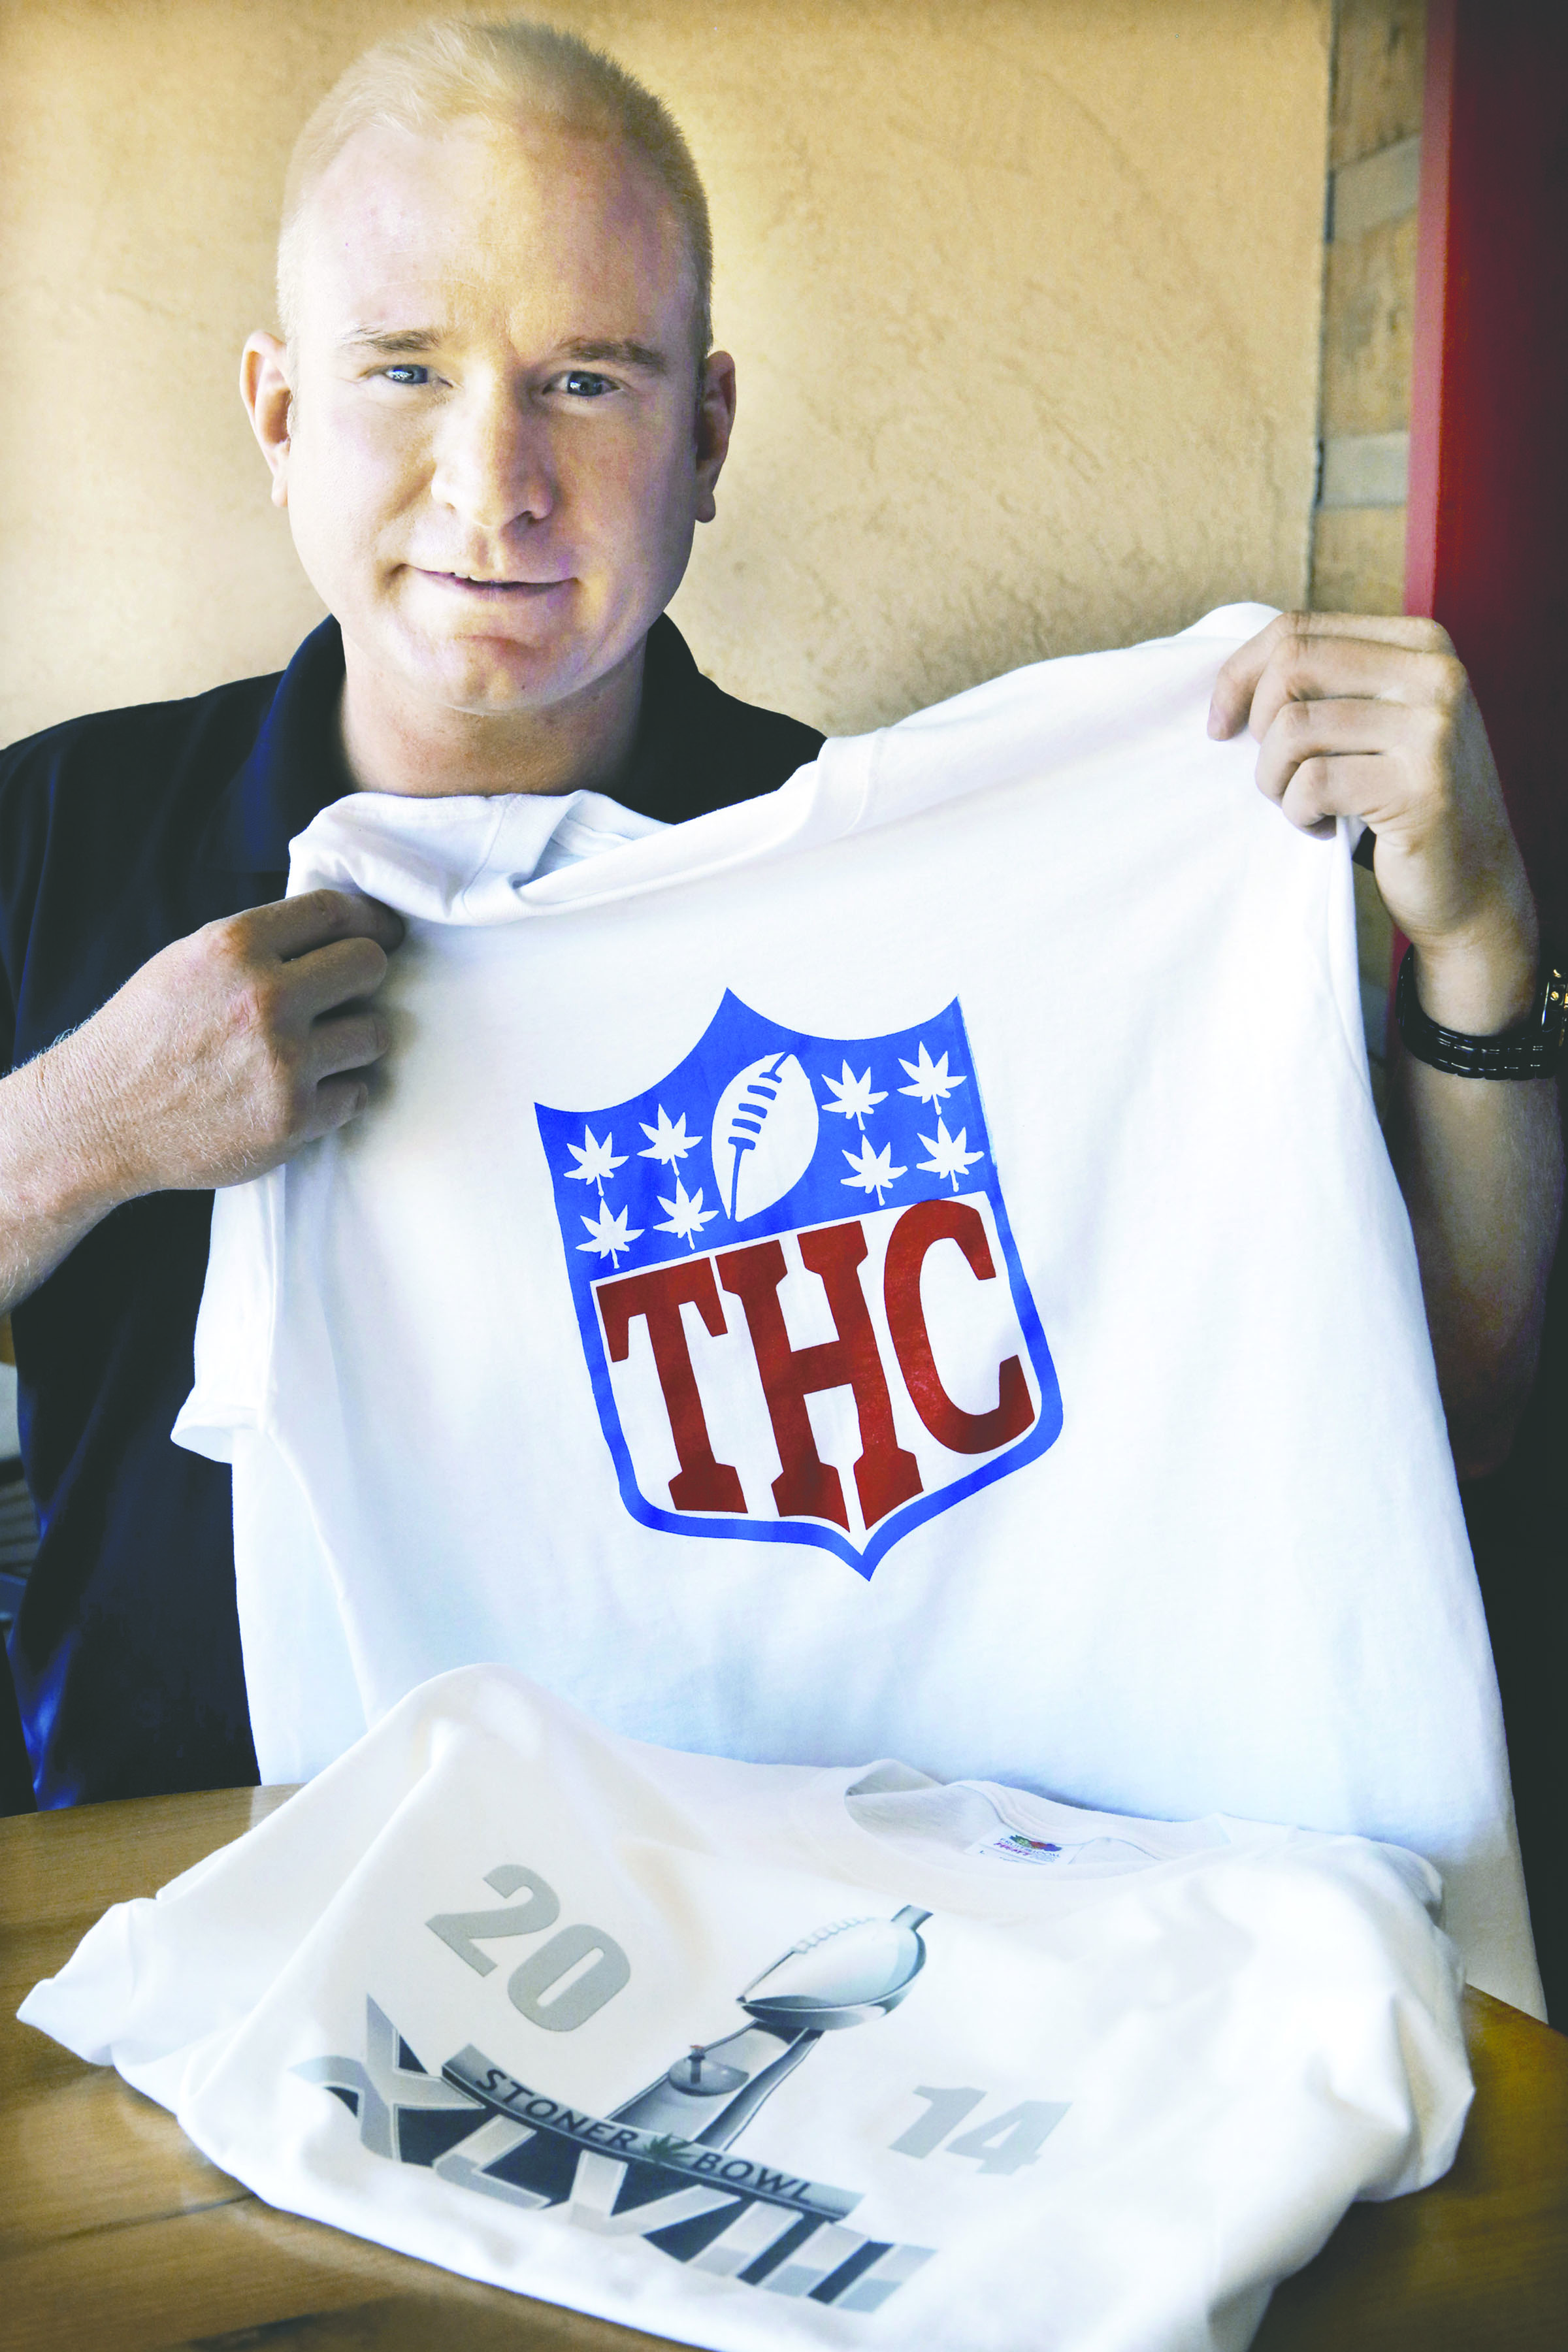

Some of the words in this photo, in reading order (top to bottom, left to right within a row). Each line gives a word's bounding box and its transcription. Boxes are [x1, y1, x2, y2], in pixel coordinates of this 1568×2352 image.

[596, 1200, 1036, 1533] THC
[425, 1864, 631, 2032] 20
[476, 2068, 639, 2147] STONER
[691, 2151, 813, 2204] BOWL
[887, 2085, 1073, 2176] 14
